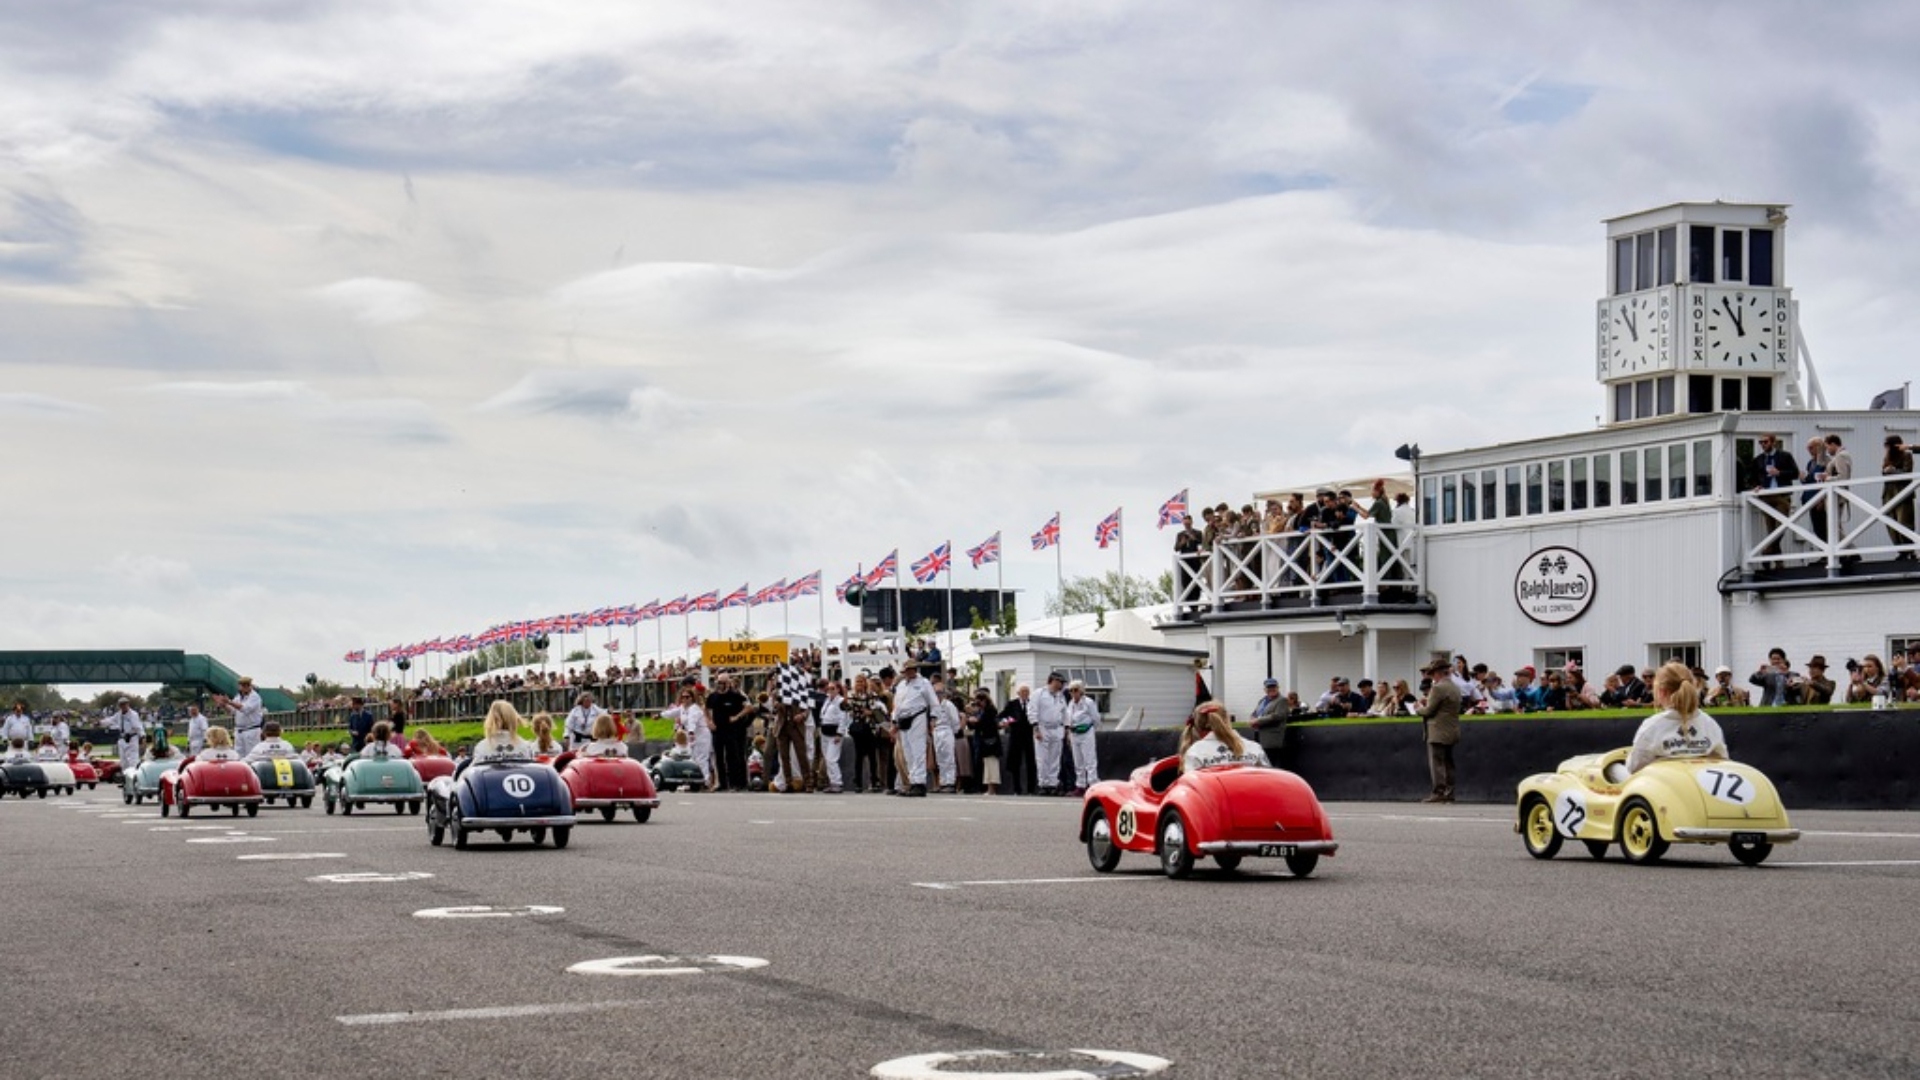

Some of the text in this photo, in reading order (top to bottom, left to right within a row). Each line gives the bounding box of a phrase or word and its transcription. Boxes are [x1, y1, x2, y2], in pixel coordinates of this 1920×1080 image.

[1600, 308, 1609, 372] ROLEX
[1661, 296, 1669, 362] ROLEX
[1693, 295, 1703, 361] ROLEX
[1776, 297, 1787, 363] ROLEX
[710, 653, 781, 665] COMPLETED
[729, 642, 760, 652] LAPS
[507, 778, 531, 792] 10
[1706, 769, 1744, 802] 72
[1560, 796, 1585, 837] 72
